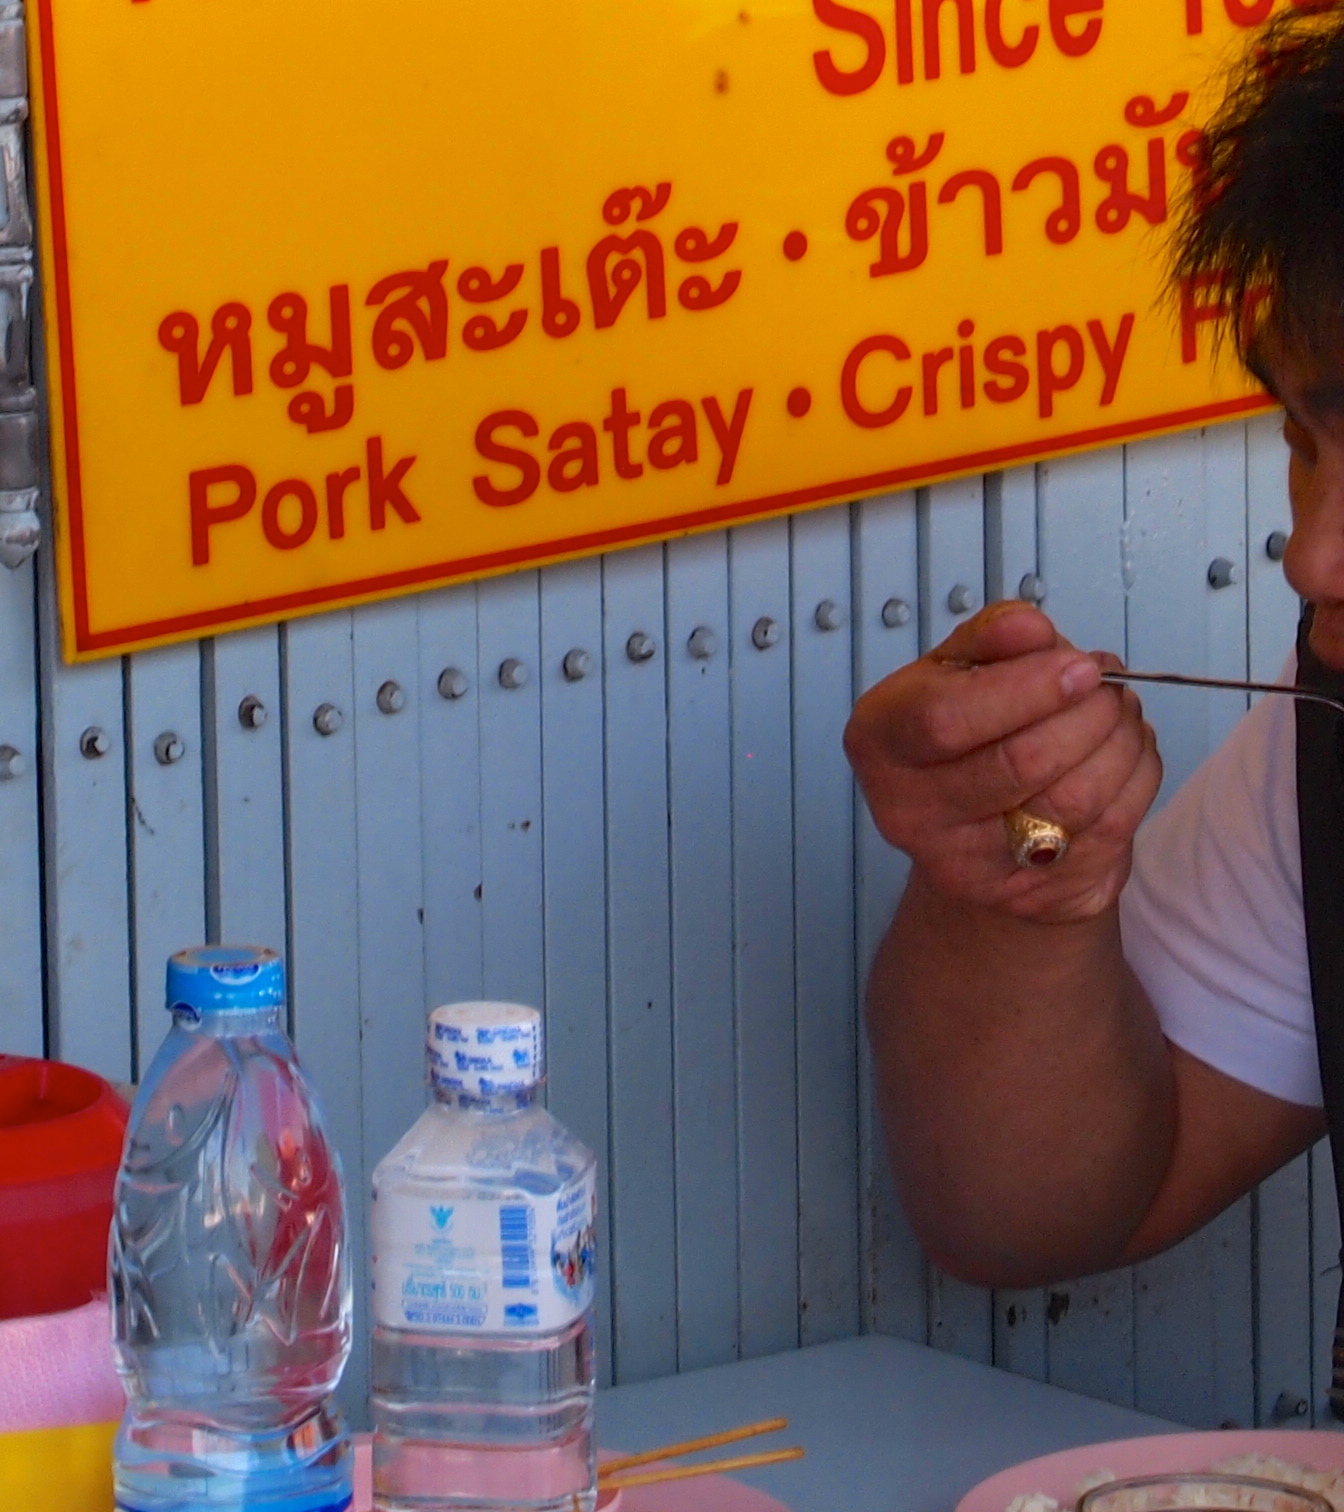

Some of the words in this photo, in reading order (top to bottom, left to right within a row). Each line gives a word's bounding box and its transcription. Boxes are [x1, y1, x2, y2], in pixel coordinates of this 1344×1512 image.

[156, 180, 744, 436] หมูสะเต๊ะ
[187, 434, 423, 568] Pork
[471, 386, 755, 510] Satay
[838, 311, 1137, 431] Crispy
